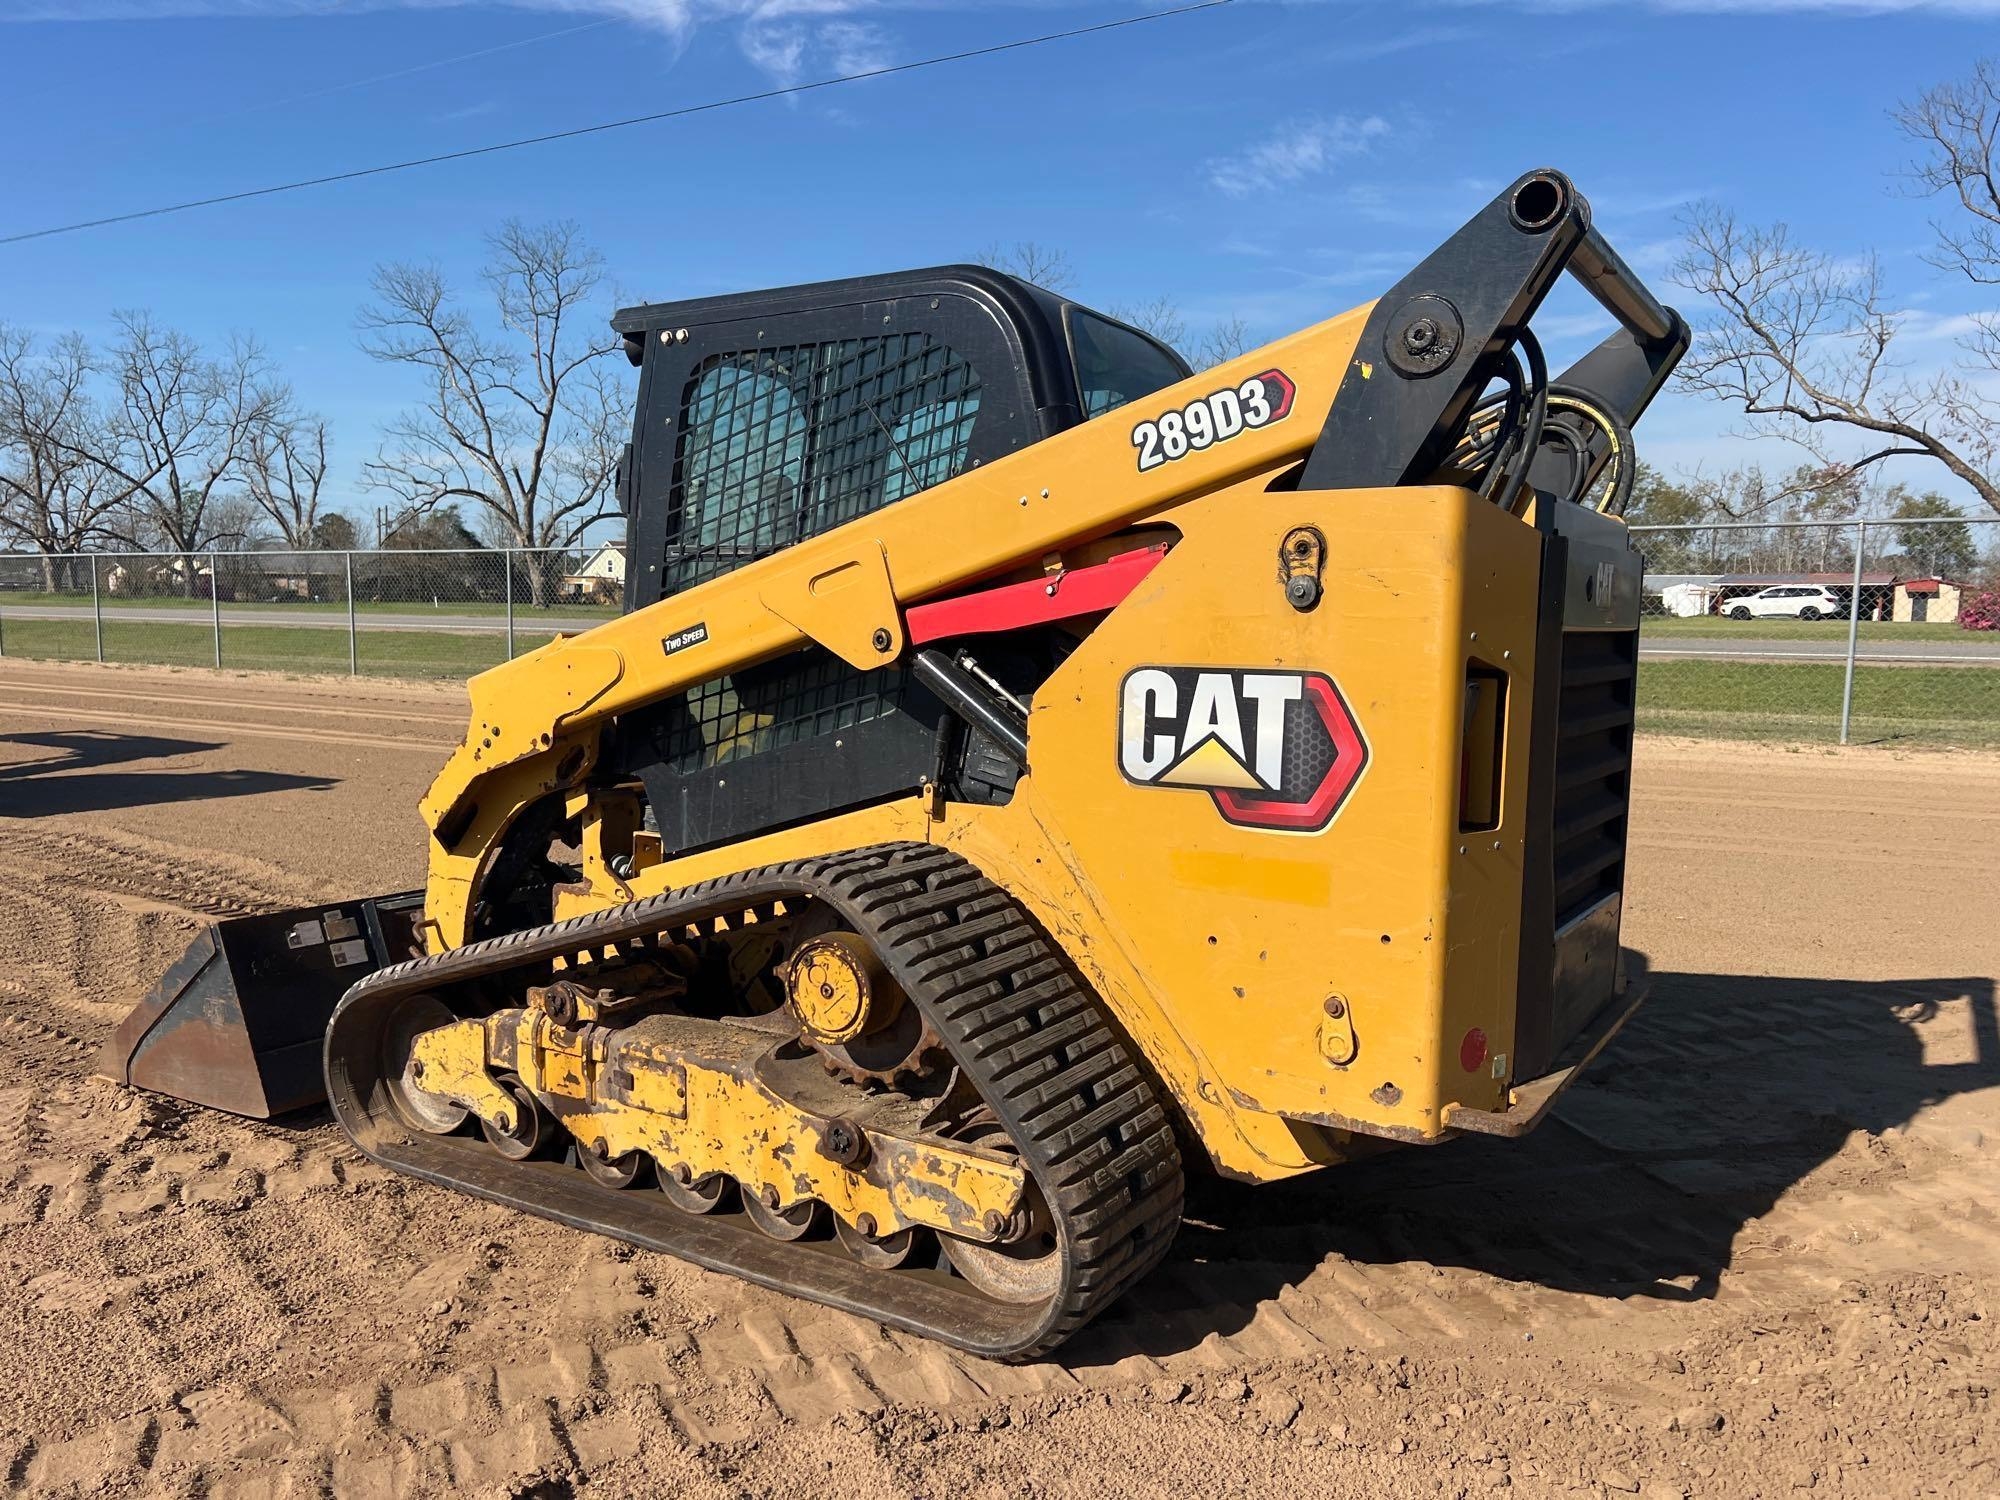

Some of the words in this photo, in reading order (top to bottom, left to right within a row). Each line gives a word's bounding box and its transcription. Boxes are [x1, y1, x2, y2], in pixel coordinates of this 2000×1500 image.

[1133, 379, 1271, 470] 289D3
[665, 638, 681, 651] TWO
[682, 628, 705, 645] SPEED
[1122, 669, 1303, 791] CAT
